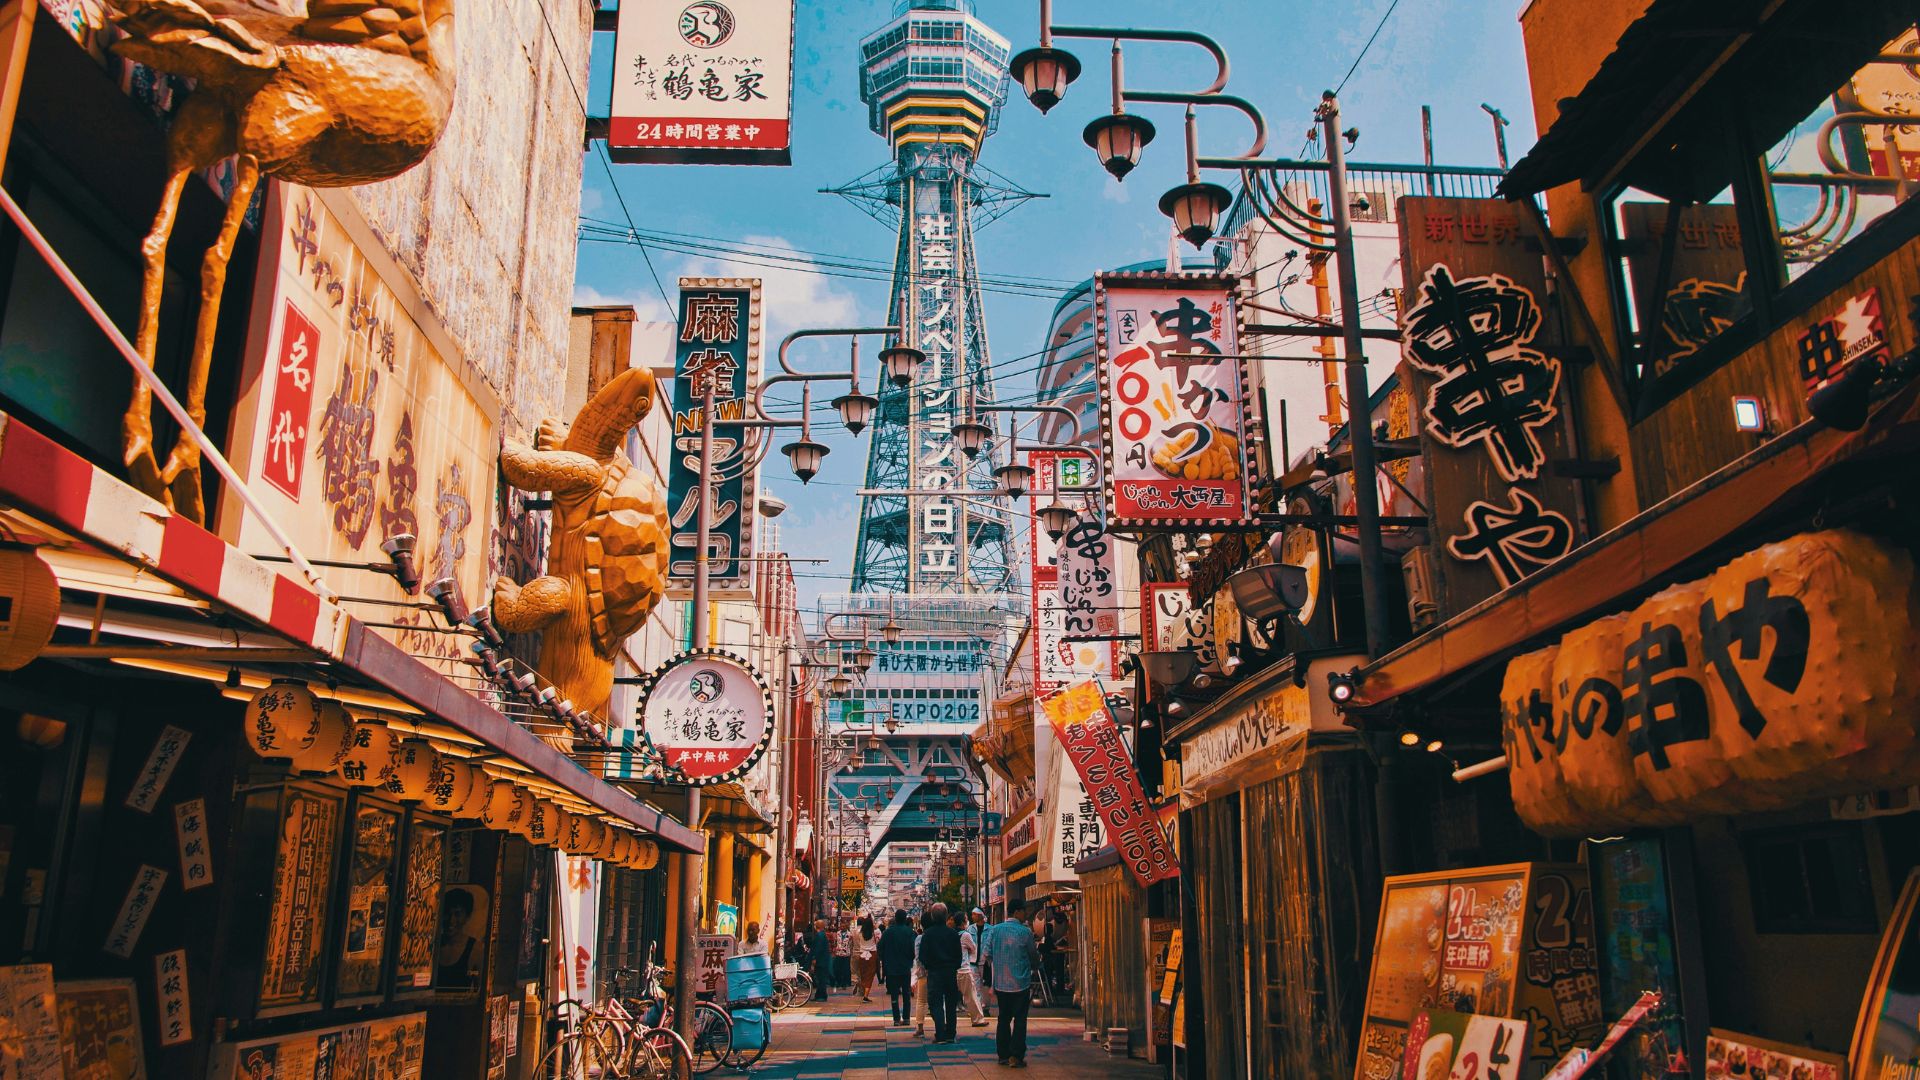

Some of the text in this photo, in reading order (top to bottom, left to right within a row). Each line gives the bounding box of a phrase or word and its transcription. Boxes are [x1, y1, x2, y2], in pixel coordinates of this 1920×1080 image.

[633, 54, 648, 86] 串かつ
[664, 54, 697, 67] 名代
[662, 66, 768, 102] 鶴亀家
[637, 123, 761, 141] 24時間営業中
[1424, 212, 1521, 243] 新世界
[1119, 312, 1137, 342] 全て
[680, 293, 740, 399] 麻雀
[1842, 332, 1883, 361] SHINSEKA
[920, 214, 956, 573] 社会イノベーションの日立
[1146, 297, 1230, 462] 串かつ
[269, 331, 311, 484] 名代
[878, 653, 981, 673] 再び大阪から世界
[256, 691, 280, 751] 鶴亀家
[892, 703, 980, 720] EXPO202
[681, 716, 748, 742] 鶴亀家
[679, 750, 730, 763] 年中無休
[1446, 944, 1491, 967] 年中無休
